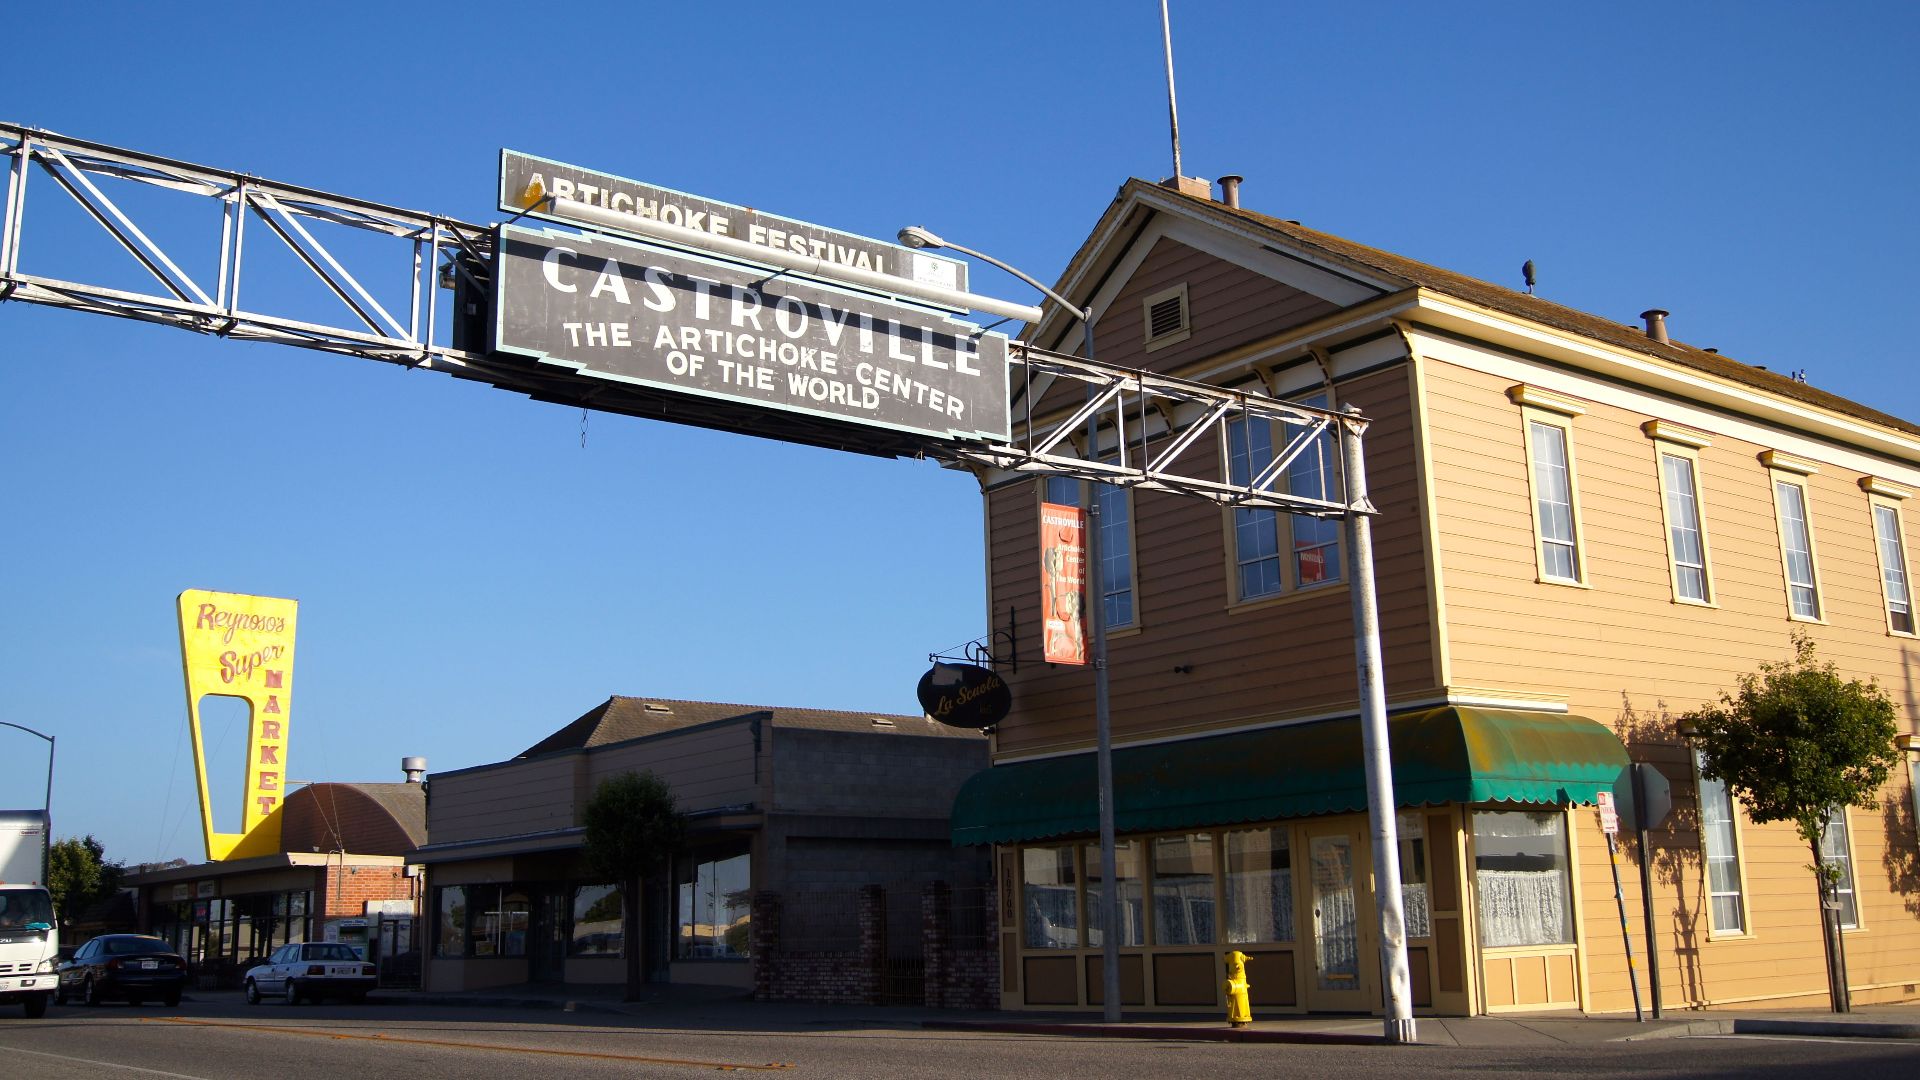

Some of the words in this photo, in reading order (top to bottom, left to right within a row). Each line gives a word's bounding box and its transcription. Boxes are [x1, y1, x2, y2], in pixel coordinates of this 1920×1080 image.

[525, 172, 729, 235] ARTICHOKE
[542, 247, 981, 377] CASTROVILLE
[563, 322, 632, 347] THE
[654, 325, 838, 375] ARTICHOKE
[855, 362, 965, 421] CENTER
[666, 351, 705, 377] OF
[718, 360, 775, 391] THE
[787, 372, 880, 410] WORLD
[1042, 515, 1084, 529] CASTROVILLE
[1057, 543, 1085, 554] Artichoke
[1066, 554, 1085, 564] Center
[1056, 572, 1067, 583] The
[1067, 575, 1085, 585] World
[196, 603, 285, 645] Reynoso's
[219, 645, 285, 684] Super
[934, 695, 954, 716] La
[956, 675, 1000, 705] Scuola
[257, 669, 283, 816] MARKET
